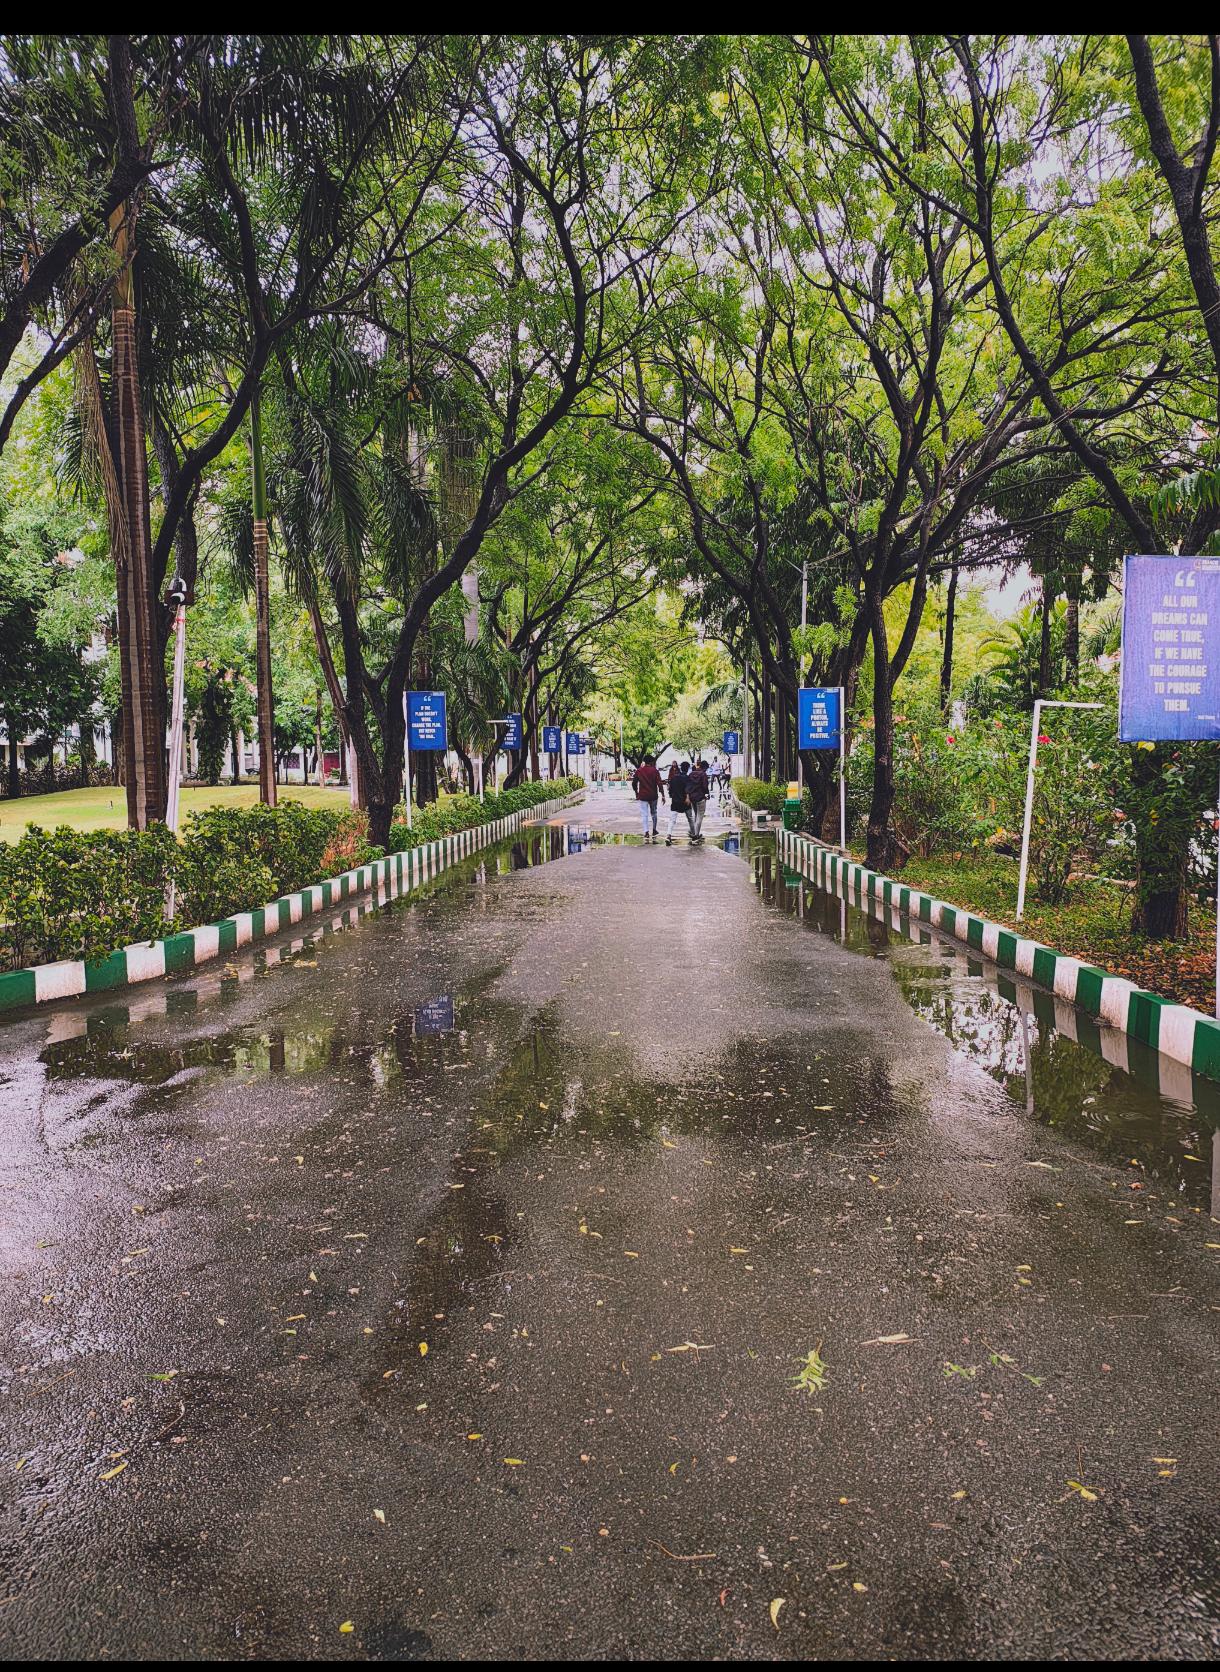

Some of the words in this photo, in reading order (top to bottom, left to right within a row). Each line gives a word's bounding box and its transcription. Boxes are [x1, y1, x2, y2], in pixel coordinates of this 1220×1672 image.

[1163, 595, 1178, 607] ALL
[1181, 595, 1198, 608] OUR
[1152, 612, 1188, 625] DREAMS
[1190, 613, 1208, 626] CAN
[1154, 630, 1179, 642] COME
[1181, 630, 1205, 644] TRUE,
[1155, 647, 1163, 660] IF
[1165, 647, 1179, 660] WE
[1181, 647, 1203, 660] HAVE
[1149, 665, 1165, 677] THE
[1167, 665, 1207, 677] COURAGE
[1154, 682, 1165, 694] TO
[1167, 682, 1201, 694] PURSUE
[1164, 699, 1190, 712] THEM.
